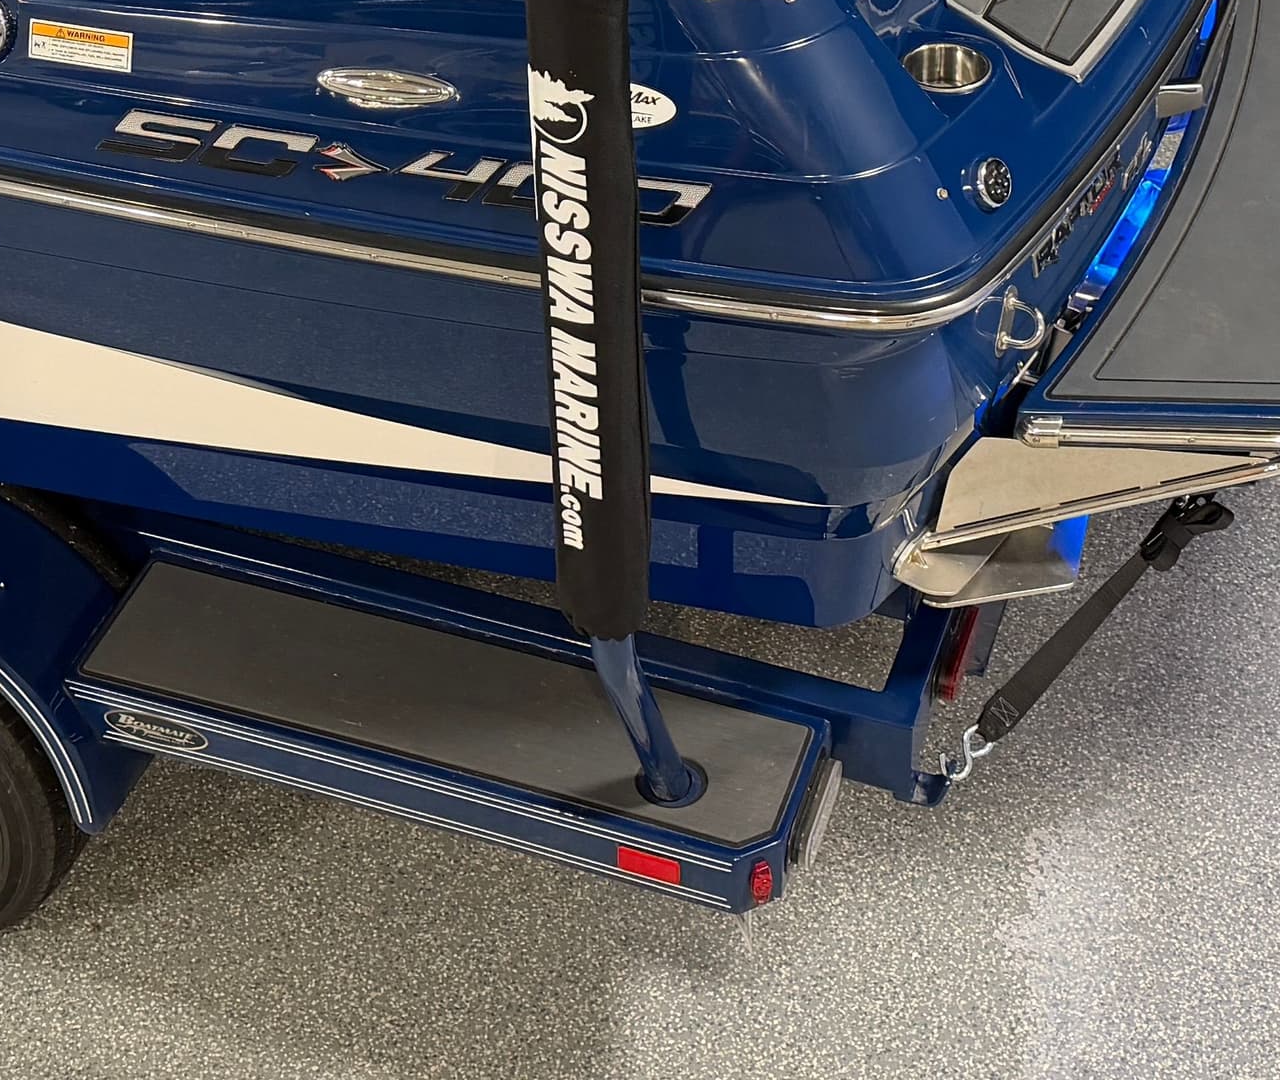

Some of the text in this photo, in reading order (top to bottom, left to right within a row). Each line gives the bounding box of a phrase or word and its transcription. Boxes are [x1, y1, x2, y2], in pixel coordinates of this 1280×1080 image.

[66, 29, 106, 43] WARNING
[539, 139, 604, 551] NISSWA MARINE.com
